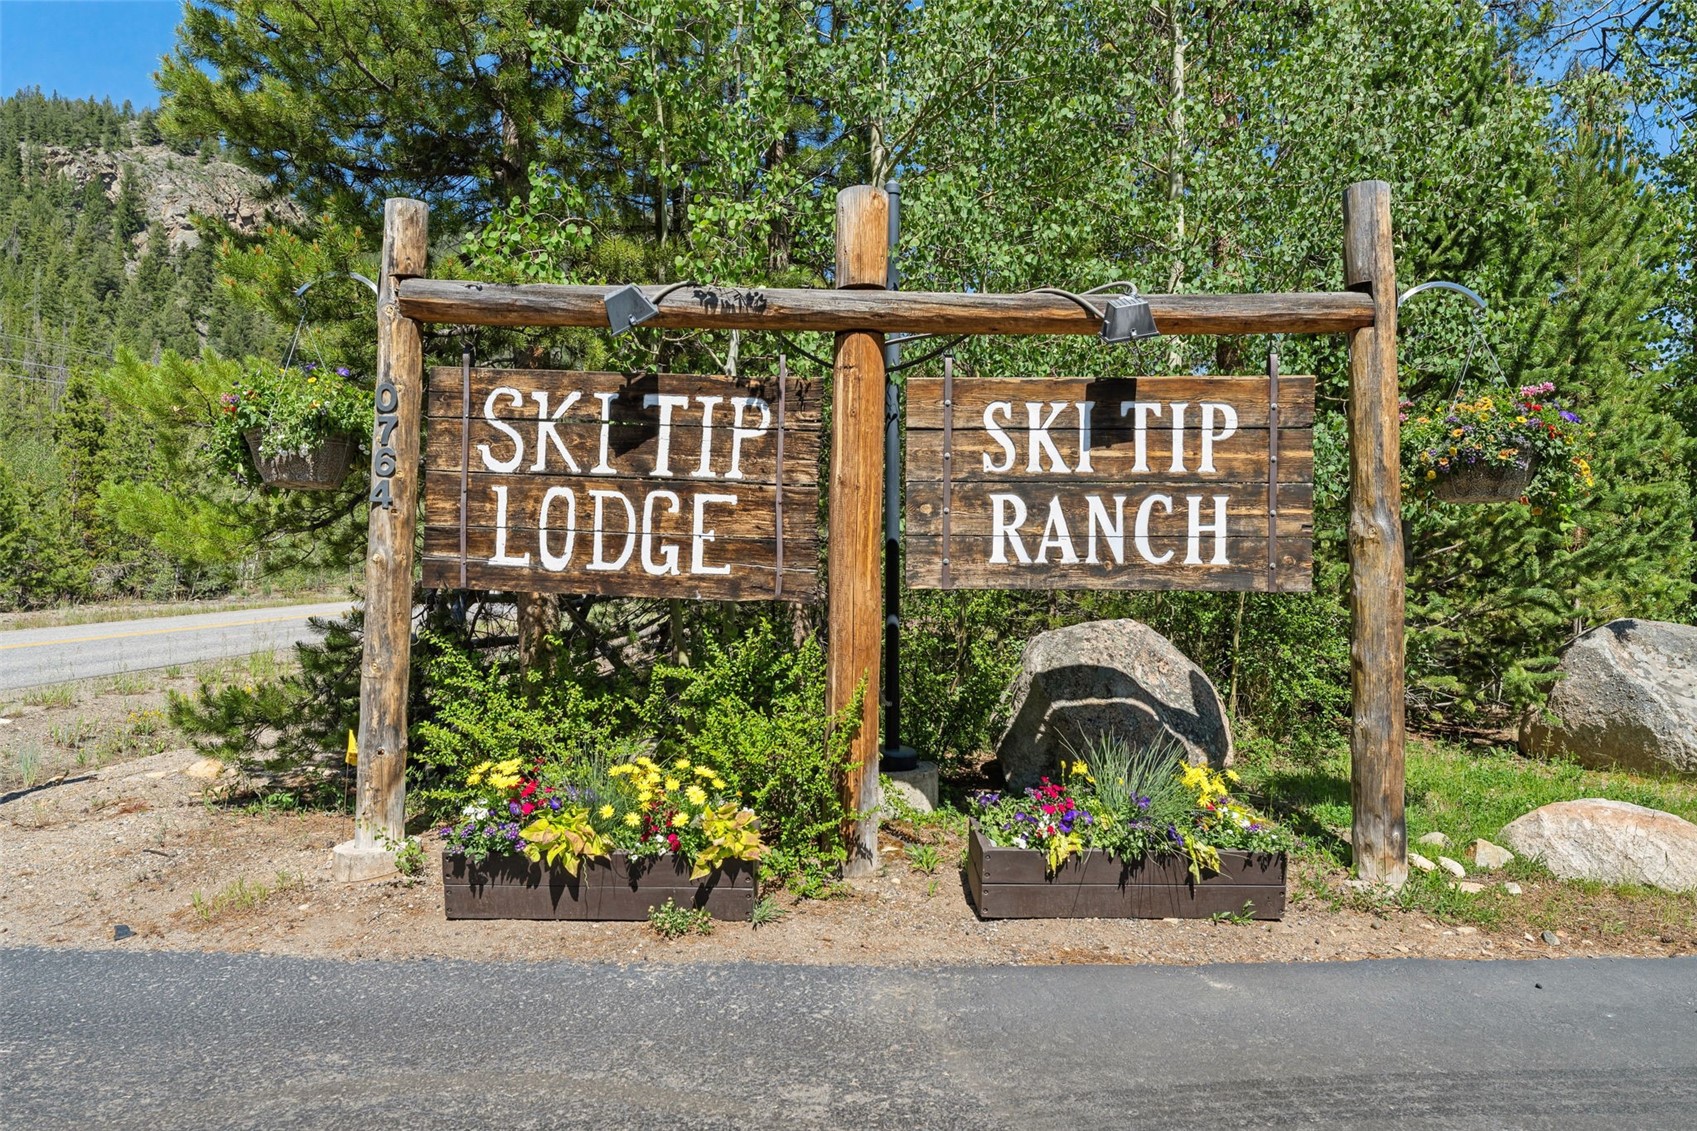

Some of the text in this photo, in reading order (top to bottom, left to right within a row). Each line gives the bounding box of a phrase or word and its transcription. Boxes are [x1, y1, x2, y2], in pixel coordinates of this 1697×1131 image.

[370, 382, 399, 510] 0764
[476, 386, 772, 480] SKI TIP
[982, 400, 1239, 474] SKI TIP
[488, 485, 739, 576] LODGE
[988, 493, 1231, 566] RANCH
